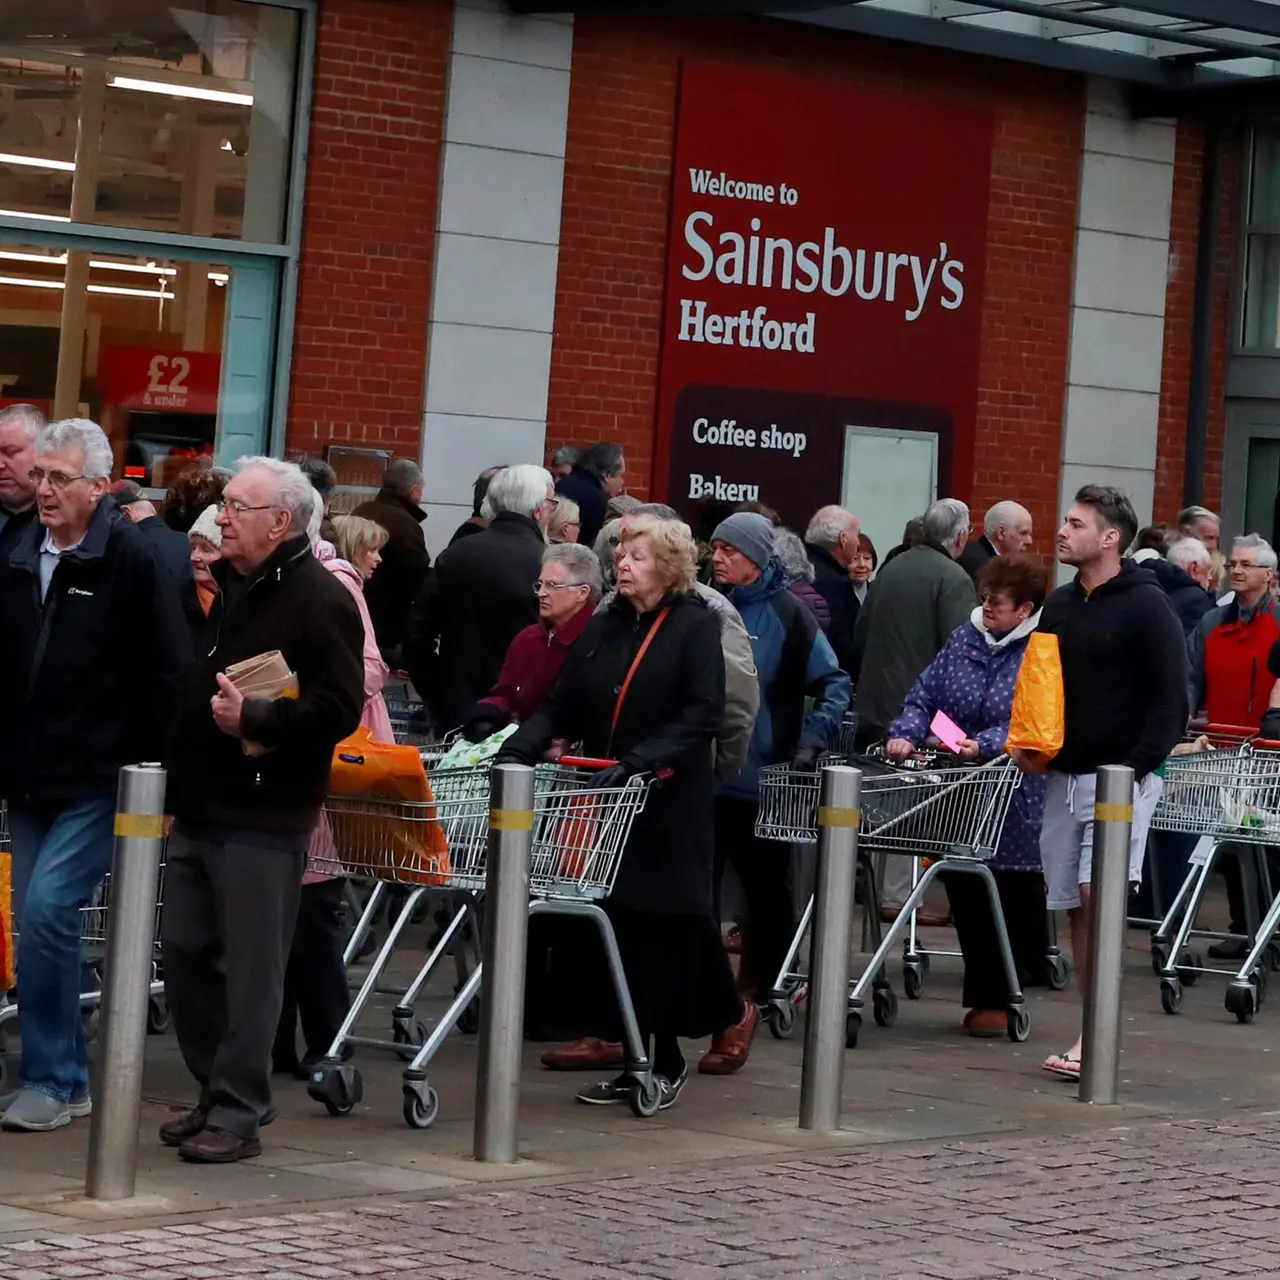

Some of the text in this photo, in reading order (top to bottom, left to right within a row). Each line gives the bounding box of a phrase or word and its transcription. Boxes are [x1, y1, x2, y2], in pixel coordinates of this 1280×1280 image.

[689, 168, 799, 206] Welcome to
[682, 210, 965, 322] Sainsbury's
[678, 298, 817, 353] Hertford
[147, 355, 190, 394] £2
[142, 392, 188, 407] & under
[693, 418, 807, 457] Coffee shop
[688, 474, 759, 502] Bakery
